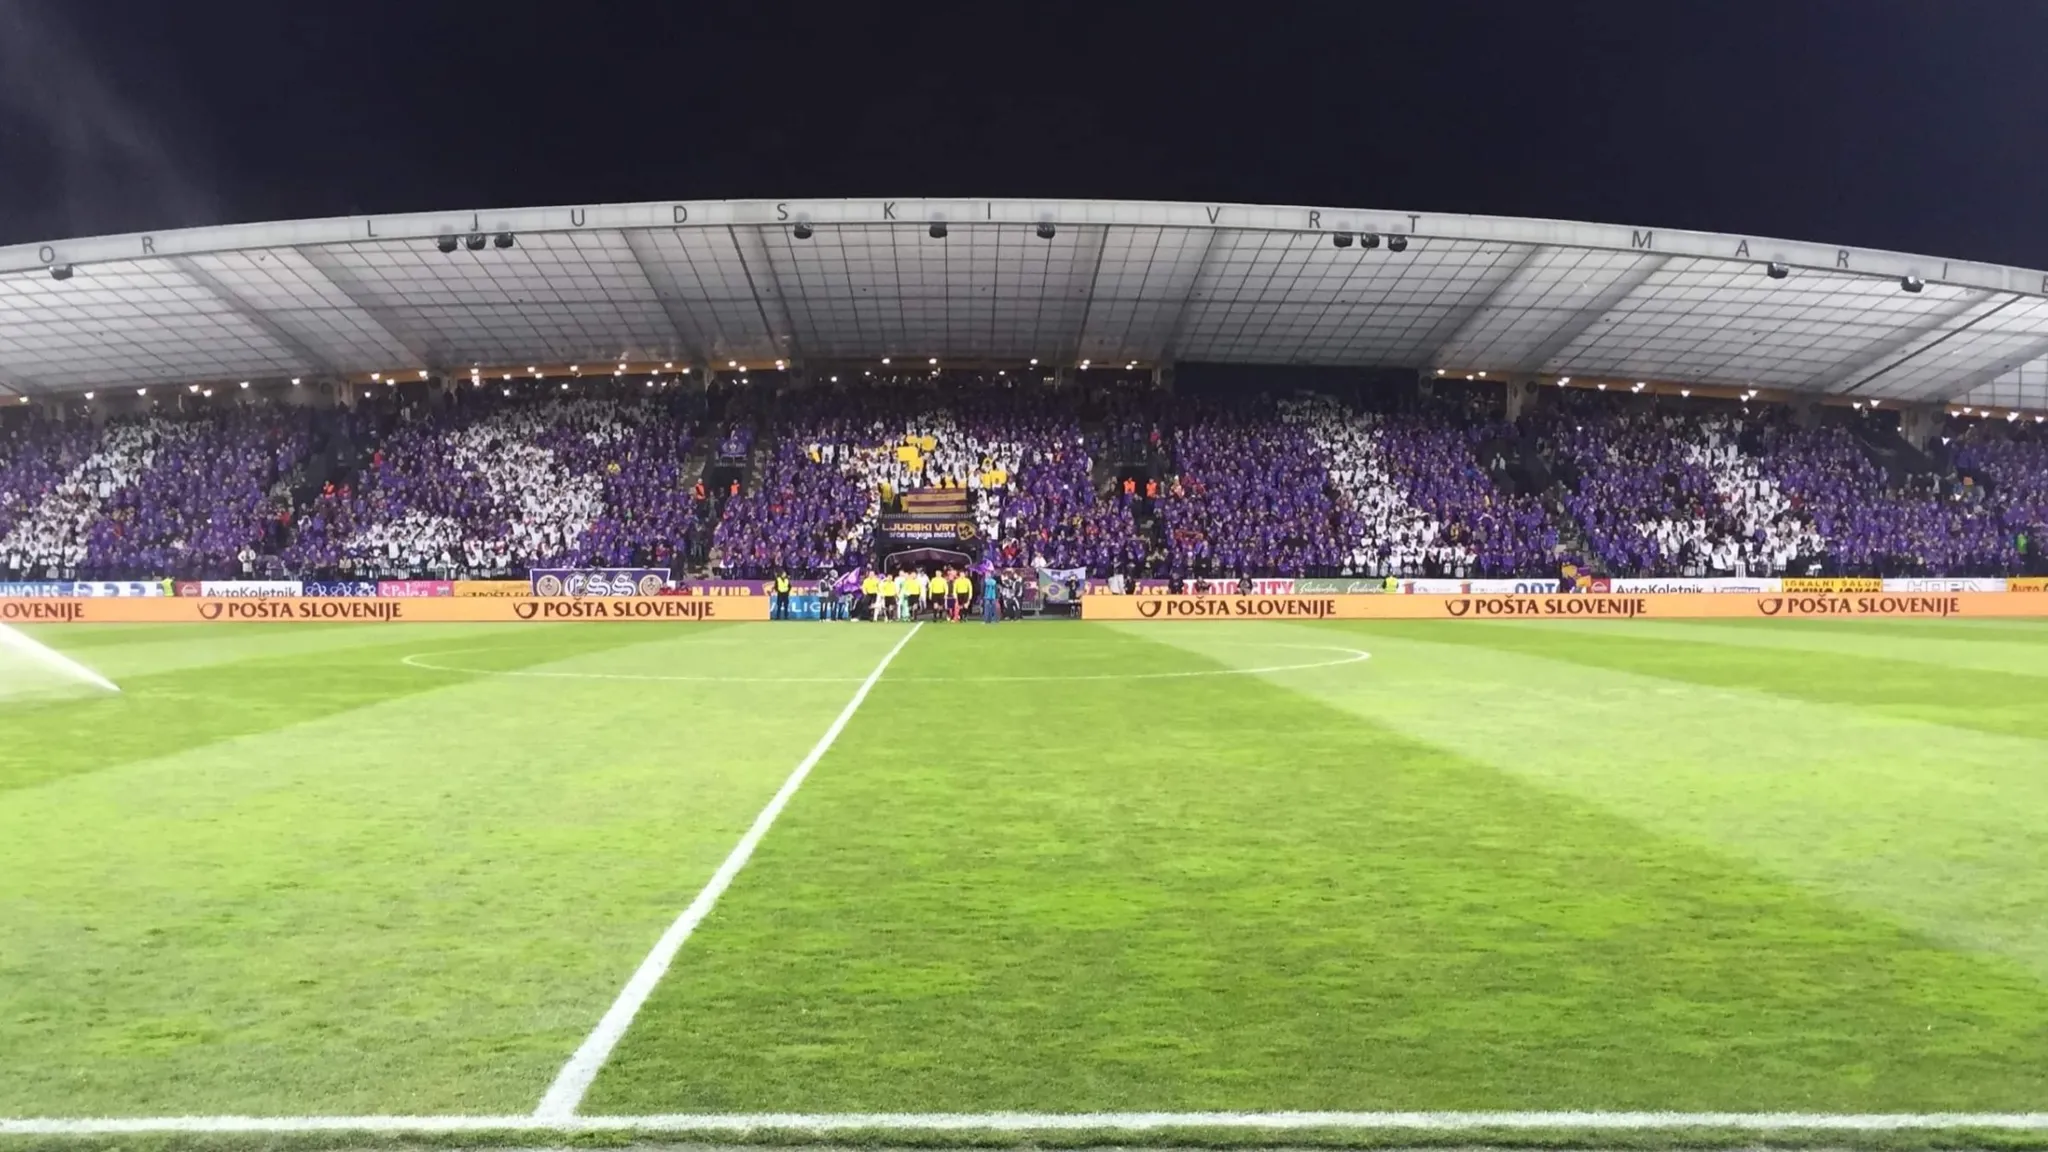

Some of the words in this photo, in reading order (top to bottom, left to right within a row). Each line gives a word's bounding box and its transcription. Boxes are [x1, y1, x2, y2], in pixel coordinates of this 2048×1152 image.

[366, 201, 992, 238] LJUDSKI
[1205, 206, 1421, 233] VRT
[934, 523, 957, 531] VRT
[2, 602, 84, 622] OVENIJE
[229, 598, 294, 617] POŠTA
[299, 602, 402, 621] SLOVENIJE
[544, 597, 608, 617] POŠTA
[613, 601, 715, 620] SLOVENIJE
[1167, 596, 1230, 615] POŠTA
[1235, 600, 1336, 619] SLOVENIJE
[1475, 595, 1539, 614] POŠTA
[1544, 599, 1646, 618] SLOVENIJE
[1787, 594, 1852, 613] POŠTA
[1857, 597, 1960, 616] SLOVENIJE
